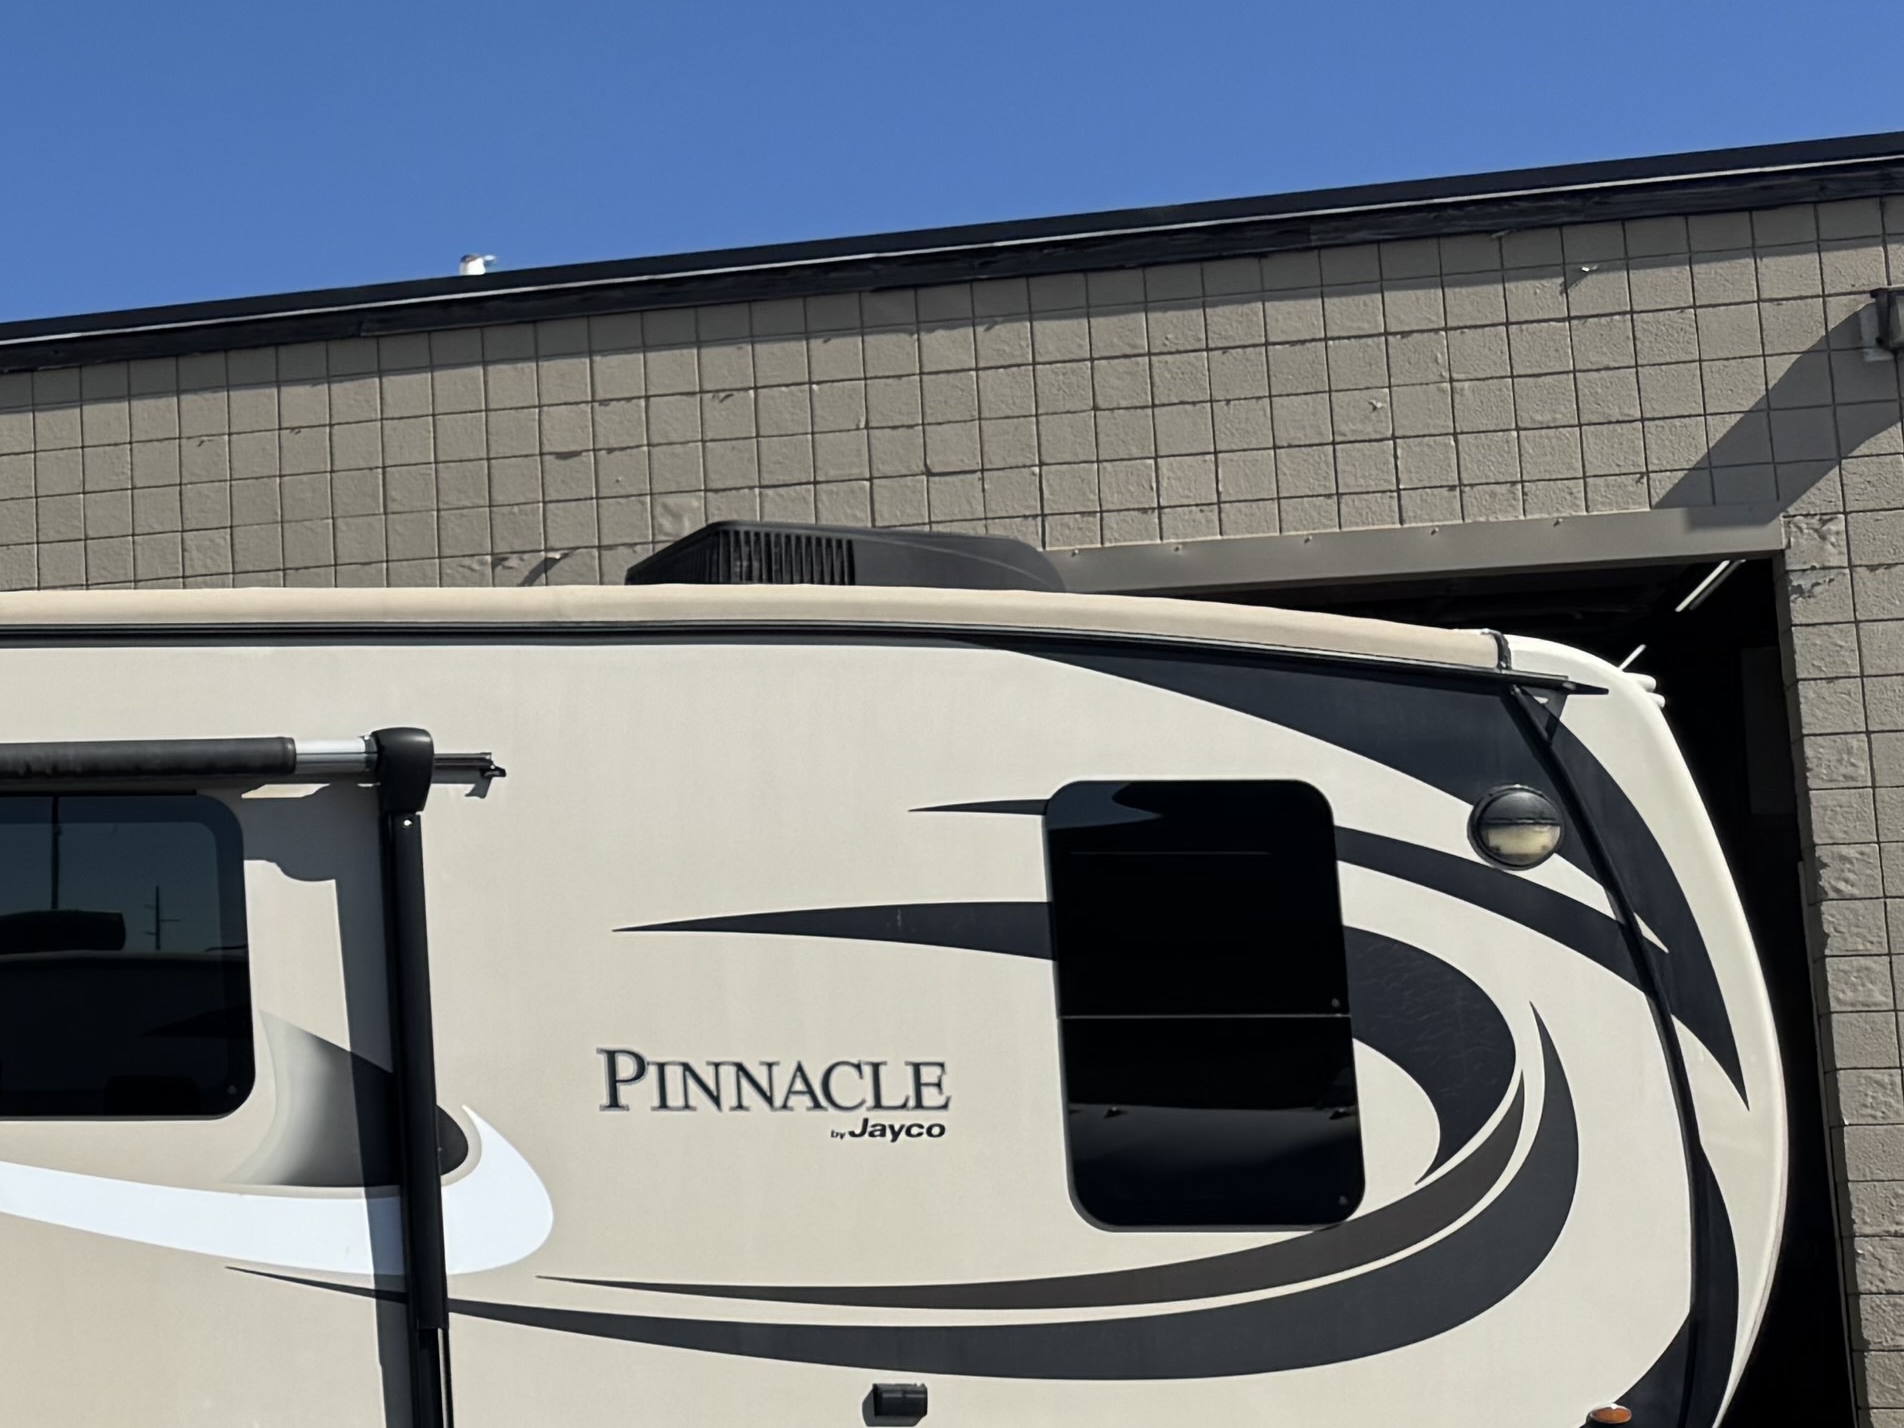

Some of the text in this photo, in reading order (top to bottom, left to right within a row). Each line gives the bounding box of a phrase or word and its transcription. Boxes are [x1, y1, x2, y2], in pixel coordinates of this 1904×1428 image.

[596, 1046, 952, 1113] PINNACLE
[830, 1117, 947, 1144] by Jayco
